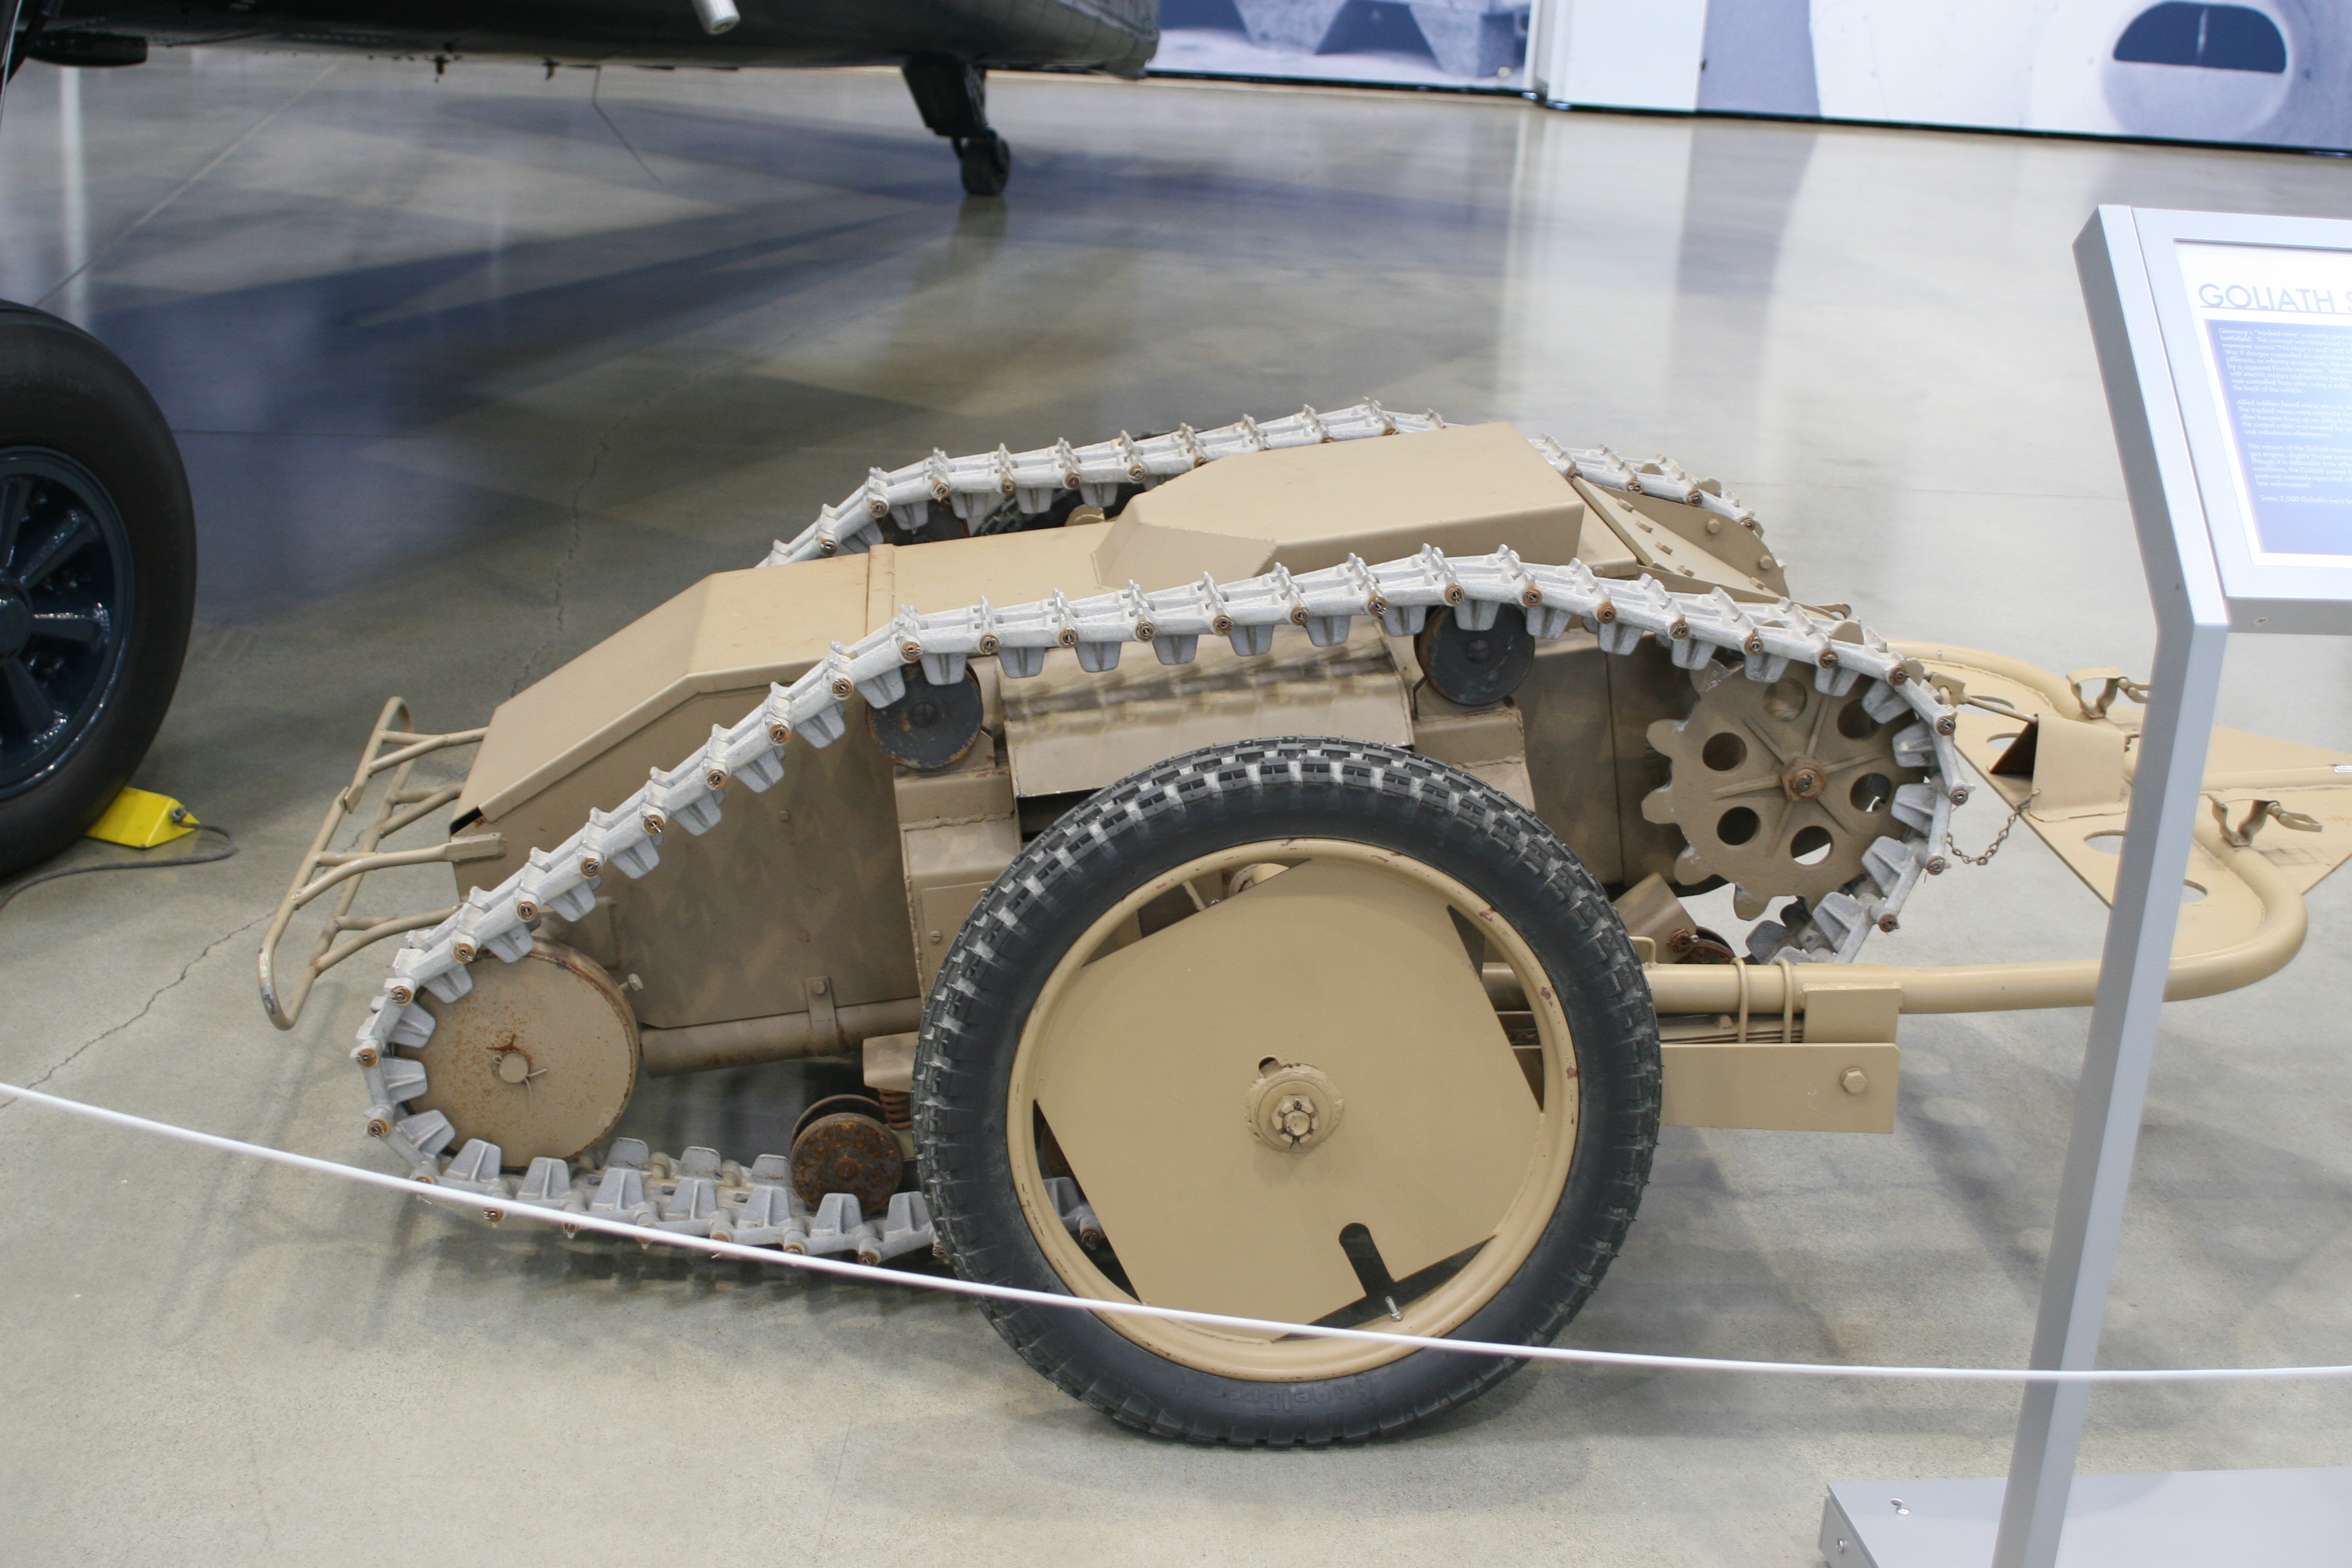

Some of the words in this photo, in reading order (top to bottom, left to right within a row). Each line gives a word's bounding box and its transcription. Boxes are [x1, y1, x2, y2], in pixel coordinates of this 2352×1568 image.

[2198, 283, 2335, 313] GOLIATH
[2218, 328, 2253, 336] Germany's
[2245, 350, 2268, 358] designs
[2266, 358, 2288, 366] infantry
[2312, 409, 2339, 418] relatively
[2284, 415, 2300, 423] hung
[2288, 452, 2309, 460] slightly
[2251, 457, 2274, 465] Though
